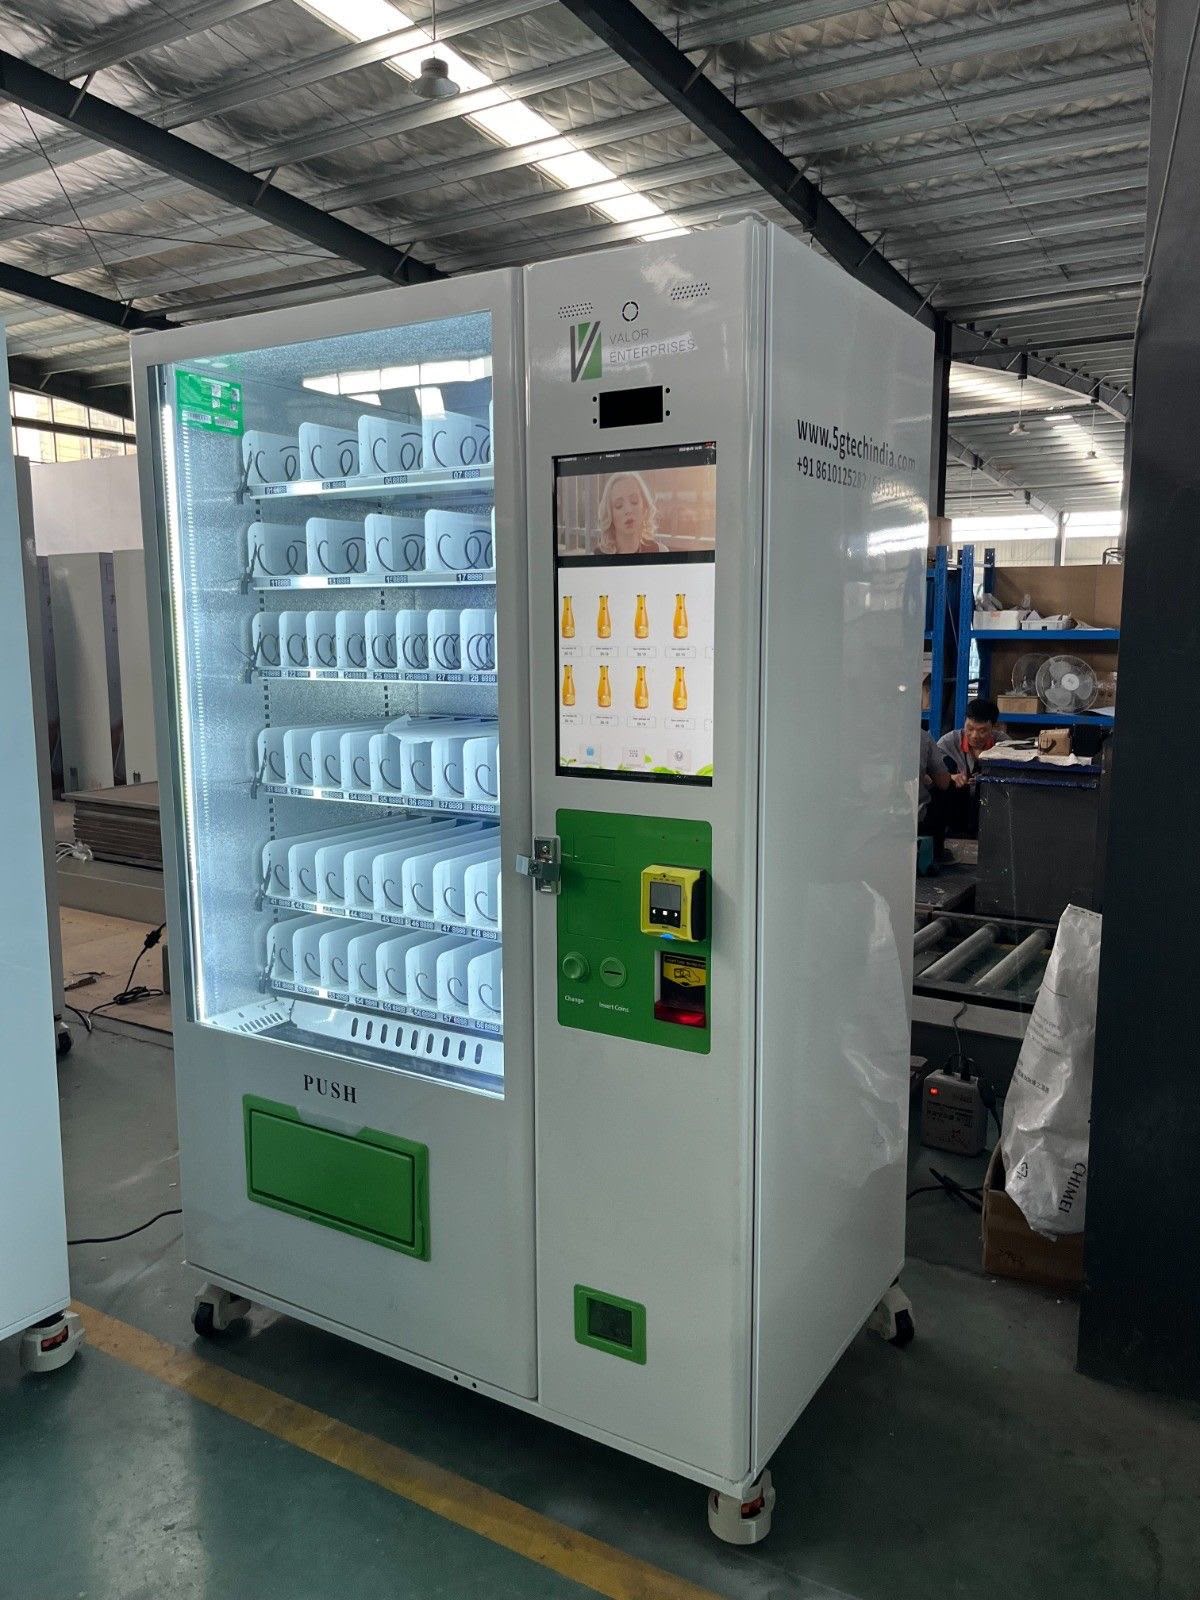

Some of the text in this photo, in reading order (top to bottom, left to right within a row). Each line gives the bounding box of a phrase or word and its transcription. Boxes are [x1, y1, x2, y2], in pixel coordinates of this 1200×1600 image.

[609, 328, 649, 345] VALOR
[609, 339, 696, 363] ENTERPRISES
[564, 995, 584, 1005] Change
[599, 1001, 629, 1013] Insert Coins
[304, 1074, 357, 1104] PUSH
[1058, 1162, 1087, 1213] CHIMEI
